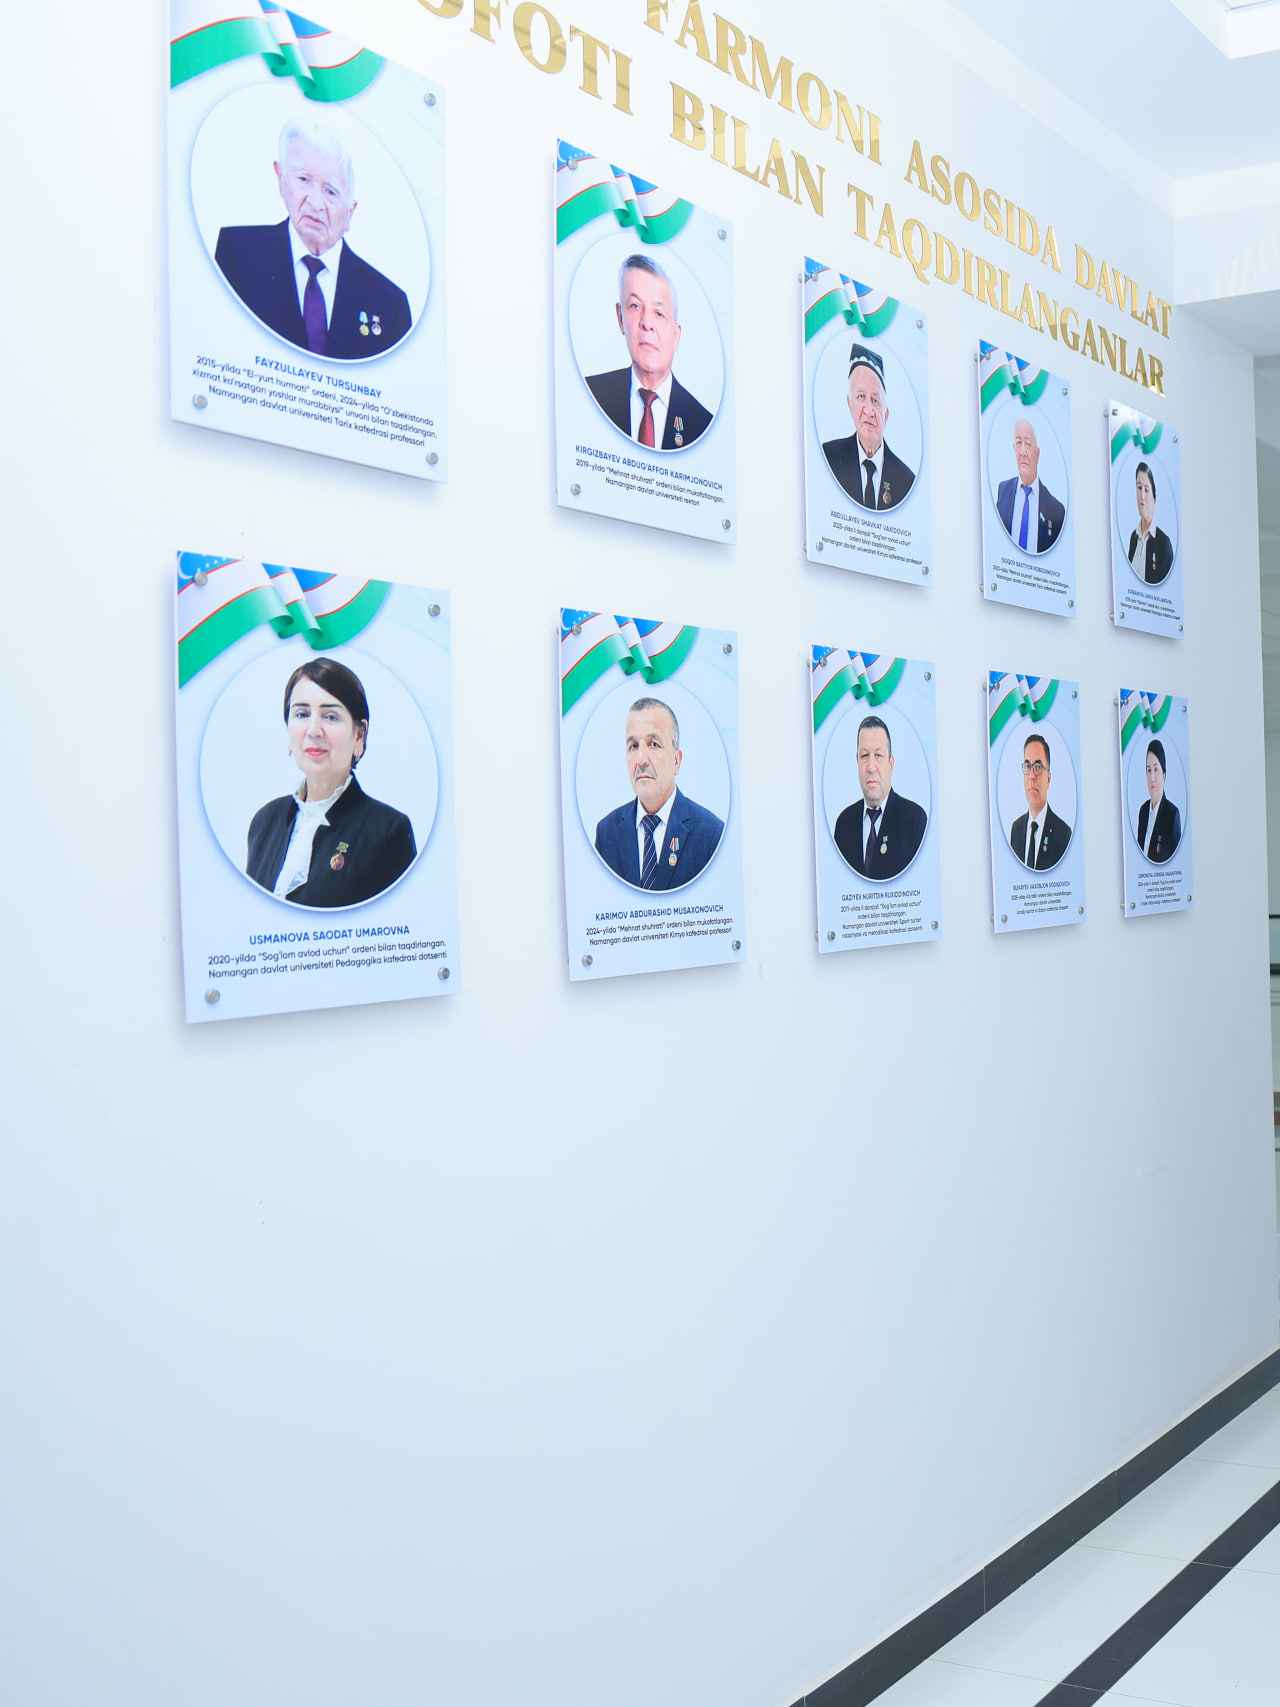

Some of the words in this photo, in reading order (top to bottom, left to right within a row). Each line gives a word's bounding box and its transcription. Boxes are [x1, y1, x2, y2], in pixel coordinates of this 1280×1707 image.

[417, 0, 634, 116] FOTI
[670, 81, 826, 217] BILAN
[848, 183, 1166, 397] TAQDIRLANGANLAR
[904, 140, 1062, 273] ASOSIDA
[1076, 244, 1173, 339] DAVLAT
[193, 368, 220, 382] xizmat
[269, 390, 296, 401] yoshlar
[346, 410, 369, 421] unvoni
[372, 415, 389, 426] bilan
[391, 421, 437, 438] taqdirlangan.
[197, 355, 241, 375] 2015-yilda
[312, 389, 338, 402] ordeni,
[340, 395, 379, 412] 2024-yilda
[256, 356, 323, 382] FAYZULLAYEV
[326, 376, 381, 398] TURSUNBAY
[209, 385, 257, 405] Namangan
[260, 399, 287, 412] davlat
[289, 408, 332, 424] universiteti
[335, 417, 352, 429] Tarix
[355, 423, 388, 438] kafedrasi
[391, 434, 424, 447] professori
[208, 953, 256, 965] 2020-yilda
[298, 948, 320, 958] avlod
[352, 944, 376, 953] ordeni
[378, 943, 396, 951] bilan
[398, 940, 446, 951] taqdirlangan.
[209, 968, 258, 978] Namangan
[261, 964, 288, 974] davlat
[290, 960, 334, 972] universiteti
[336, 957, 381, 968] Pedagogika
[384, 953, 417, 963] kafedrasi
[419, 950, 447, 960] dotsenti
[250, 932, 310, 945] USMANOVA
[313, 929, 352, 940] SAODAT
[356, 926, 410, 937] UMAROVNA
